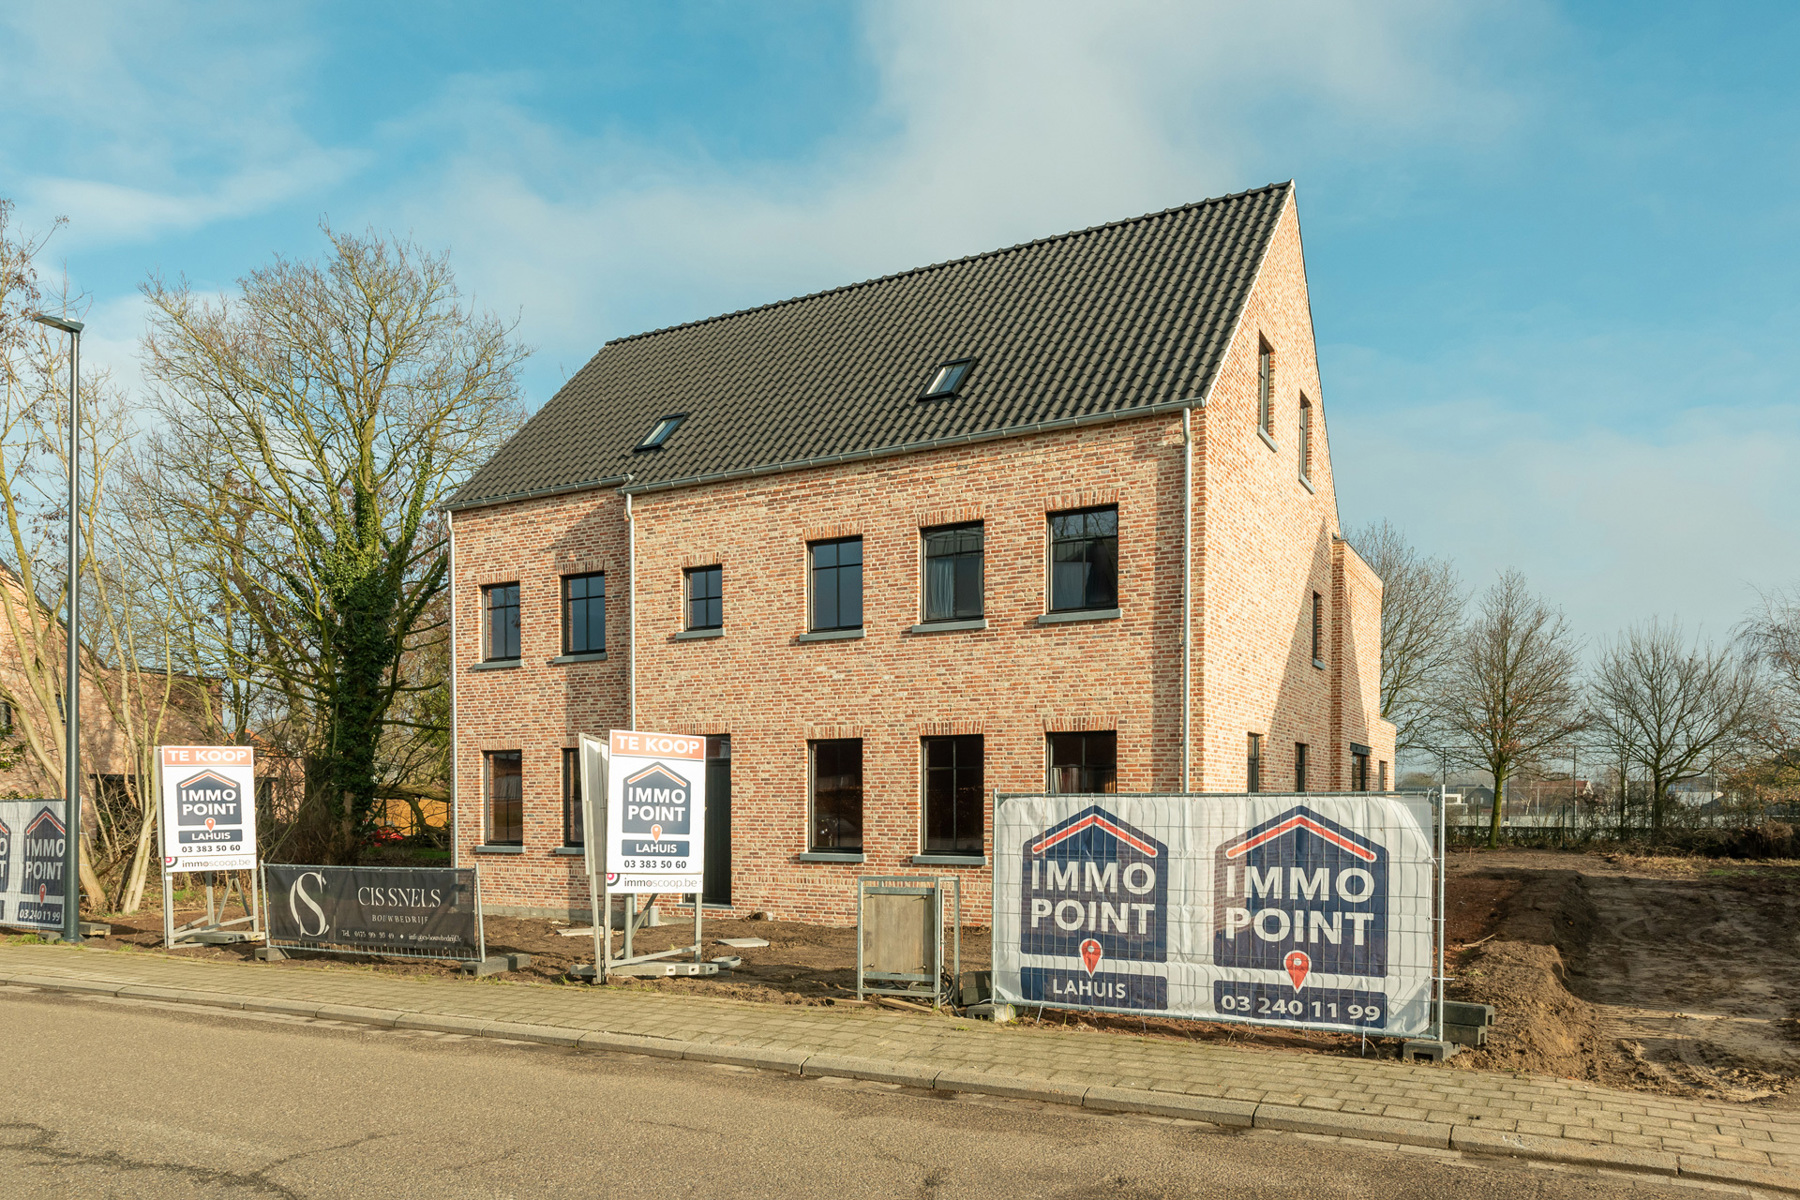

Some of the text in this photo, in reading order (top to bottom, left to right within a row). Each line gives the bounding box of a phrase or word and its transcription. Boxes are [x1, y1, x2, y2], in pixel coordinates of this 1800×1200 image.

[617, 735, 699, 754] TE KOOP
[168, 750, 247, 762] TE KOOP
[181, 789, 236, 802] IMMO
[628, 787, 686, 804] IMMO
[182, 803, 237, 816] POINT
[628, 805, 686, 821] POINT
[191, 832, 231, 841] LAHUIS
[26, 838, 66, 858] IMMO
[181, 845, 193, 853] 03
[196, 845, 213, 853] 383
[229, 844, 241, 852] 60
[635, 843, 677, 854] LAHUIS
[25, 861, 63, 880] POINT
[182, 858, 251, 869] immoscoop.be
[624, 860, 687, 869] 03 383 50 60
[624, 877, 698, 889] immoscoop.be
[1031, 860, 1156, 895] IMMO
[1226, 865, 1375, 903] IMMO
[357, 886, 442, 908] CIS SNELS
[19, 909, 29, 919] 03
[29, 910, 42, 920] 240
[51, 911, 61, 922] 99
[1031, 898, 1156, 935] POINT
[1225, 907, 1375, 946] POINT
[1052, 978, 1126, 999] LAHUIS
[1221, 995, 1381, 1021] 03 240 11 99
